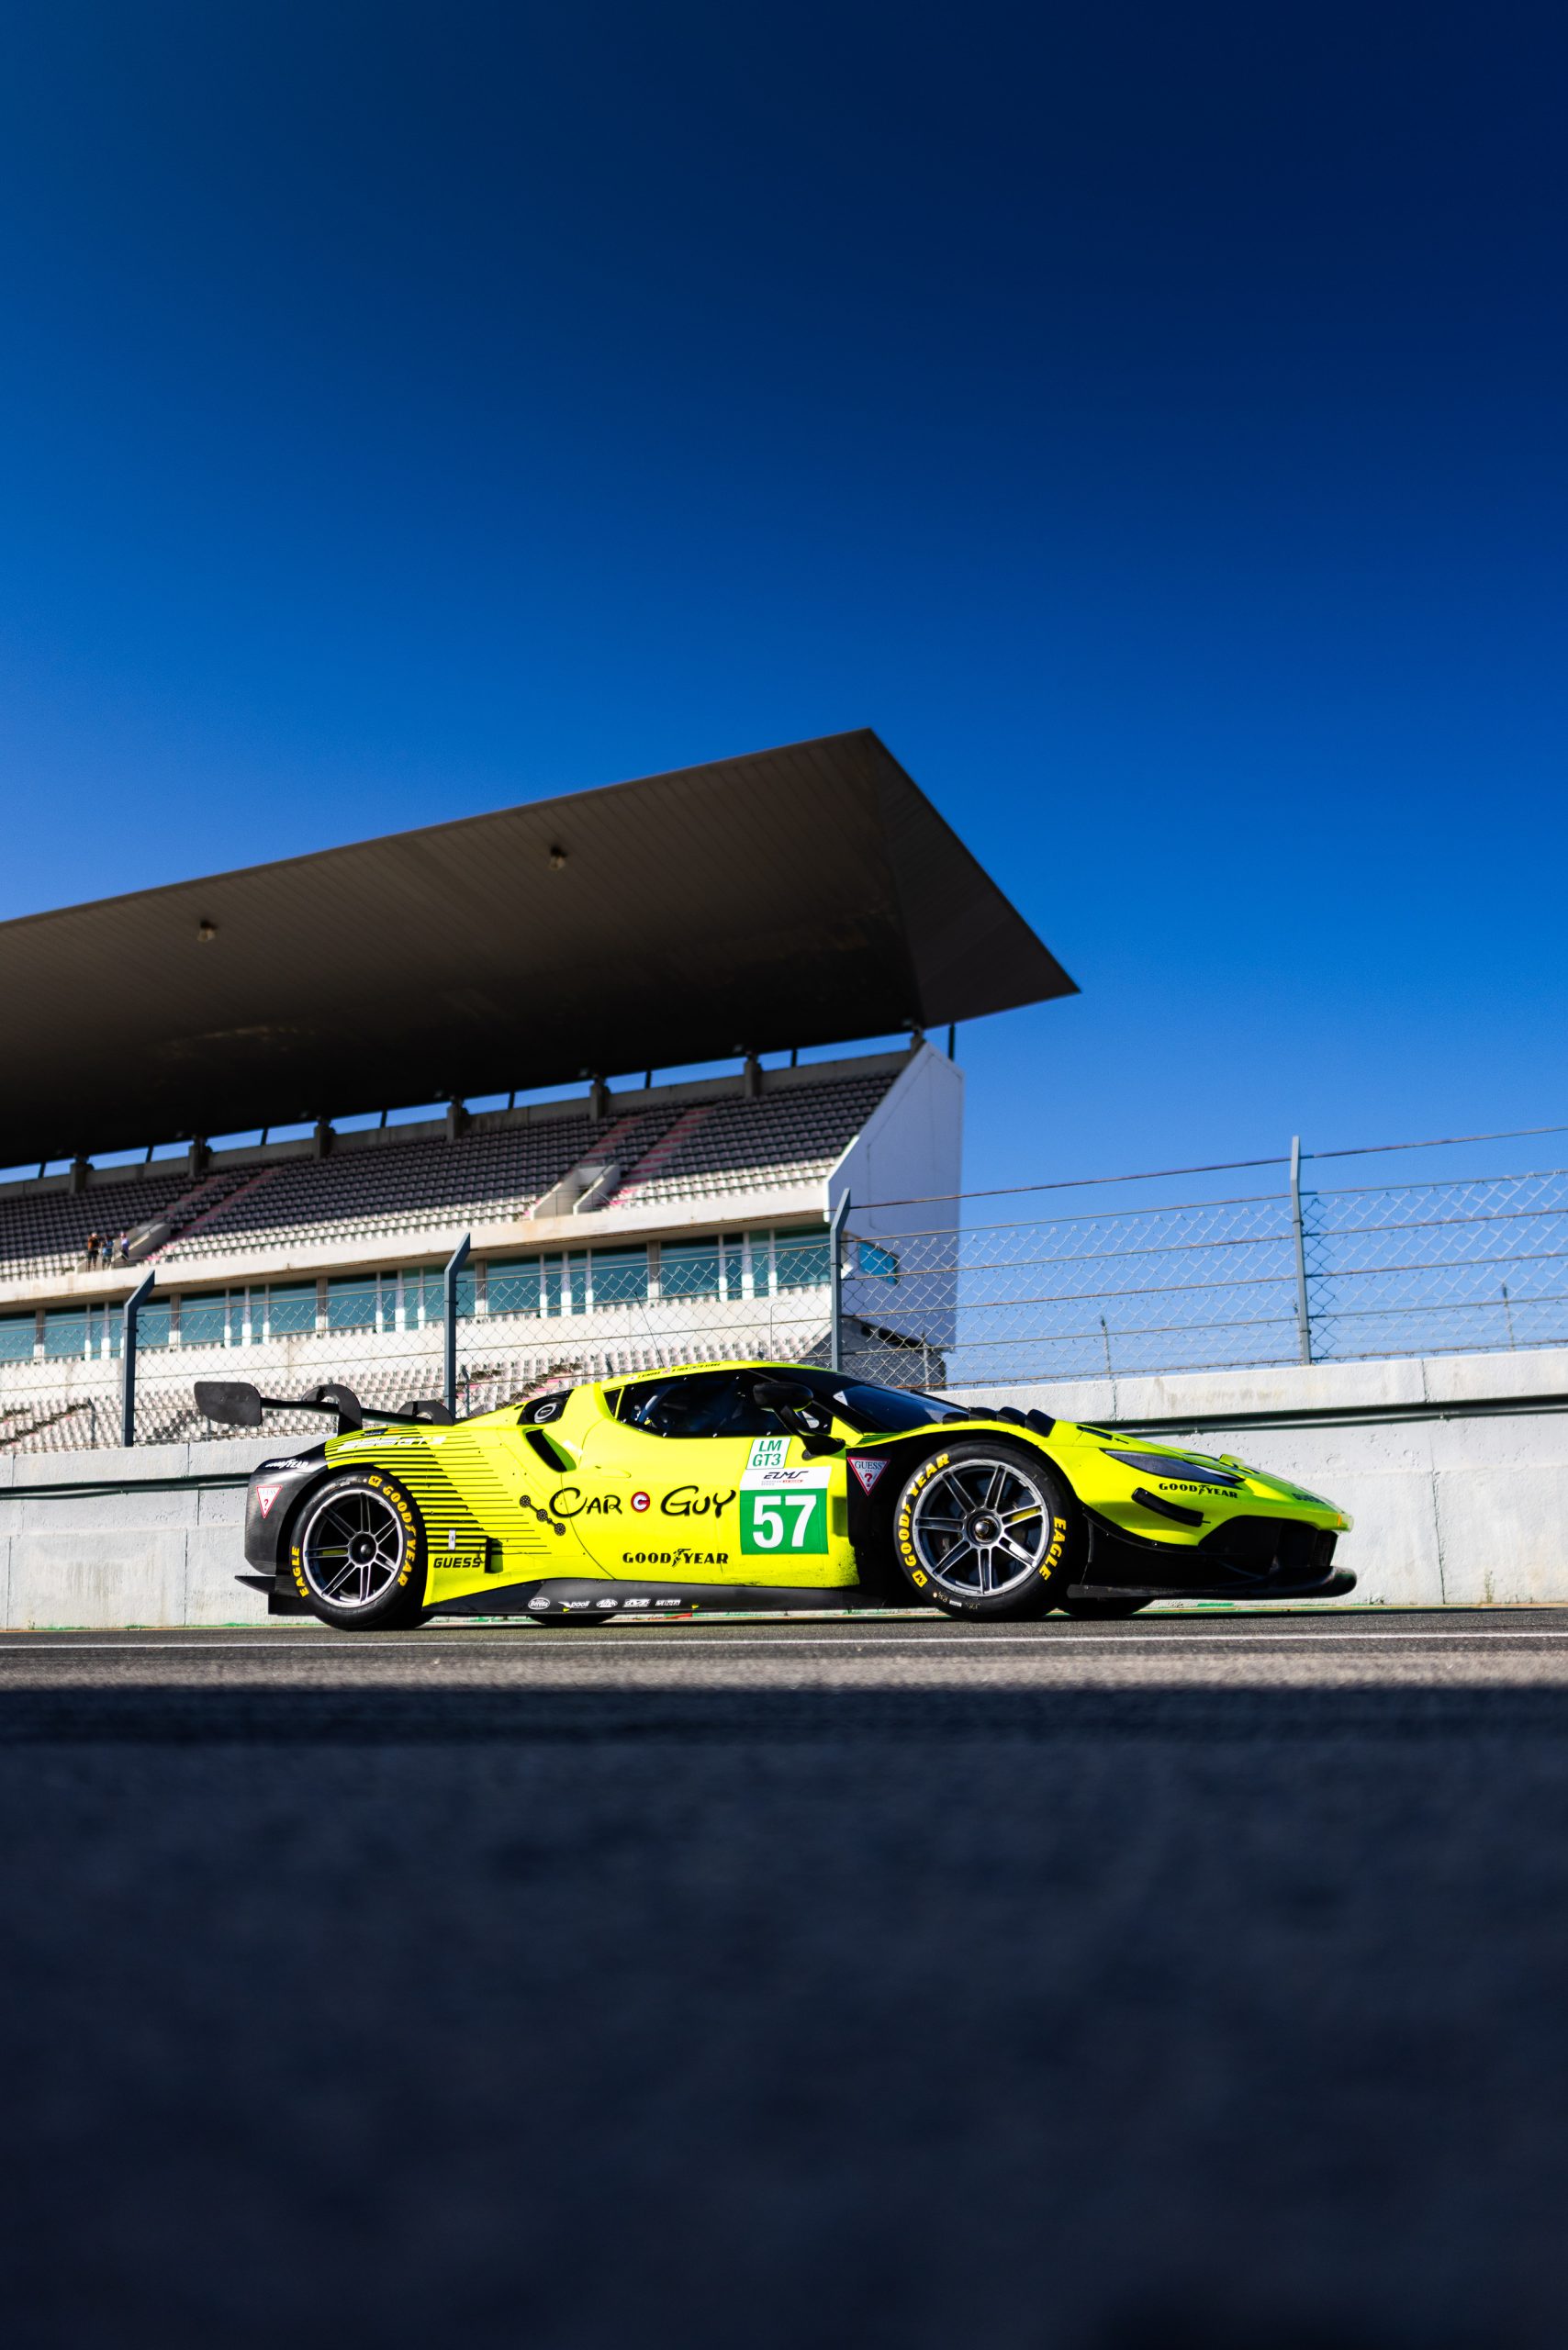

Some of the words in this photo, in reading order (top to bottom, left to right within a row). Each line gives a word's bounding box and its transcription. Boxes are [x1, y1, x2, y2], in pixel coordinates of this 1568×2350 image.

[758, 1439, 783, 1452] LM
[752, 1453, 781, 1467] GT3
[855, 1460, 882, 1470] GUESS
[1159, 1483, 1238, 1498] GOODYEAR
[753, 1494, 817, 1549] 57
[1039, 1516, 1067, 1581] EAGLE
[433, 1557, 482, 1569] GUESS
[622, 1549, 729, 1565] GOODYEAR
[291, 1546, 309, 1597] EAGLE
